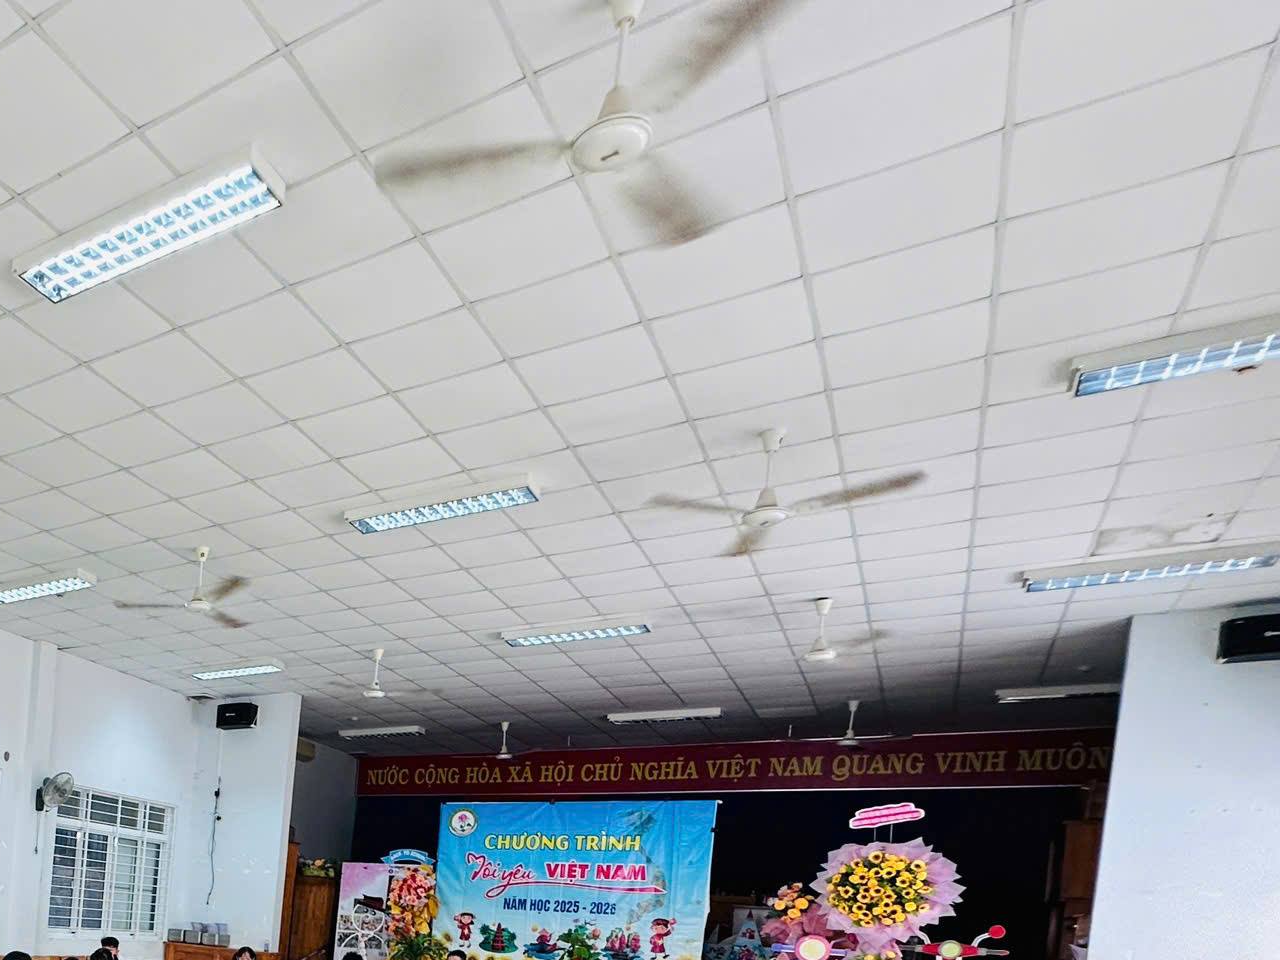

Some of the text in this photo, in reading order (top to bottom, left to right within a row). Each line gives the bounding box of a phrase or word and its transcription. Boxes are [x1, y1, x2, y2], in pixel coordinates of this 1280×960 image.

[367, 742, 1110, 788] NƯỚC CỘNG HÒA XÃ HỘI CHỦ NGHĨA VIỆT NAM QUANG VINH MUÔN
[484, 831, 641, 851] CHƯƠNG TRÌNH
[546, 860, 588, 884] VIỆT
[595, 864, 647, 881] NAM
[503, 896, 527, 911] NĂM
[529, 899, 551, 914] HỌC
[553, 900, 580, 913] 2025
